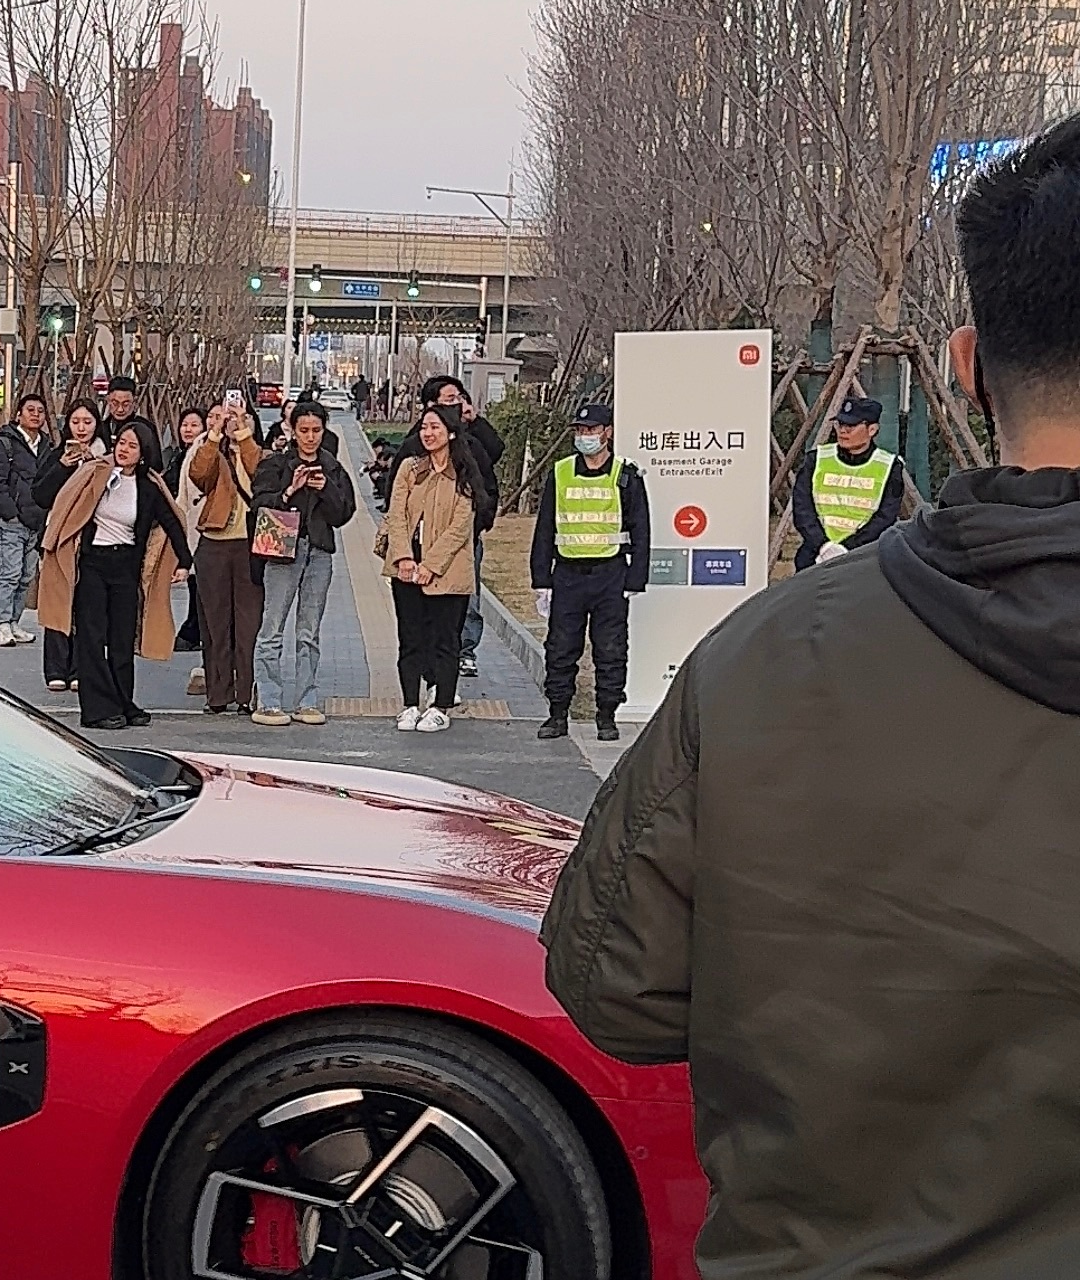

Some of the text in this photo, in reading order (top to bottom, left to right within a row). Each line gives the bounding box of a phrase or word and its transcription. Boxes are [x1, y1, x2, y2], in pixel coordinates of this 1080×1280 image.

[639, 431, 745, 451] 地库出入口
[651, 457, 733, 467] Basement Garage
[660, 468, 723, 477] Entrance/Exit
